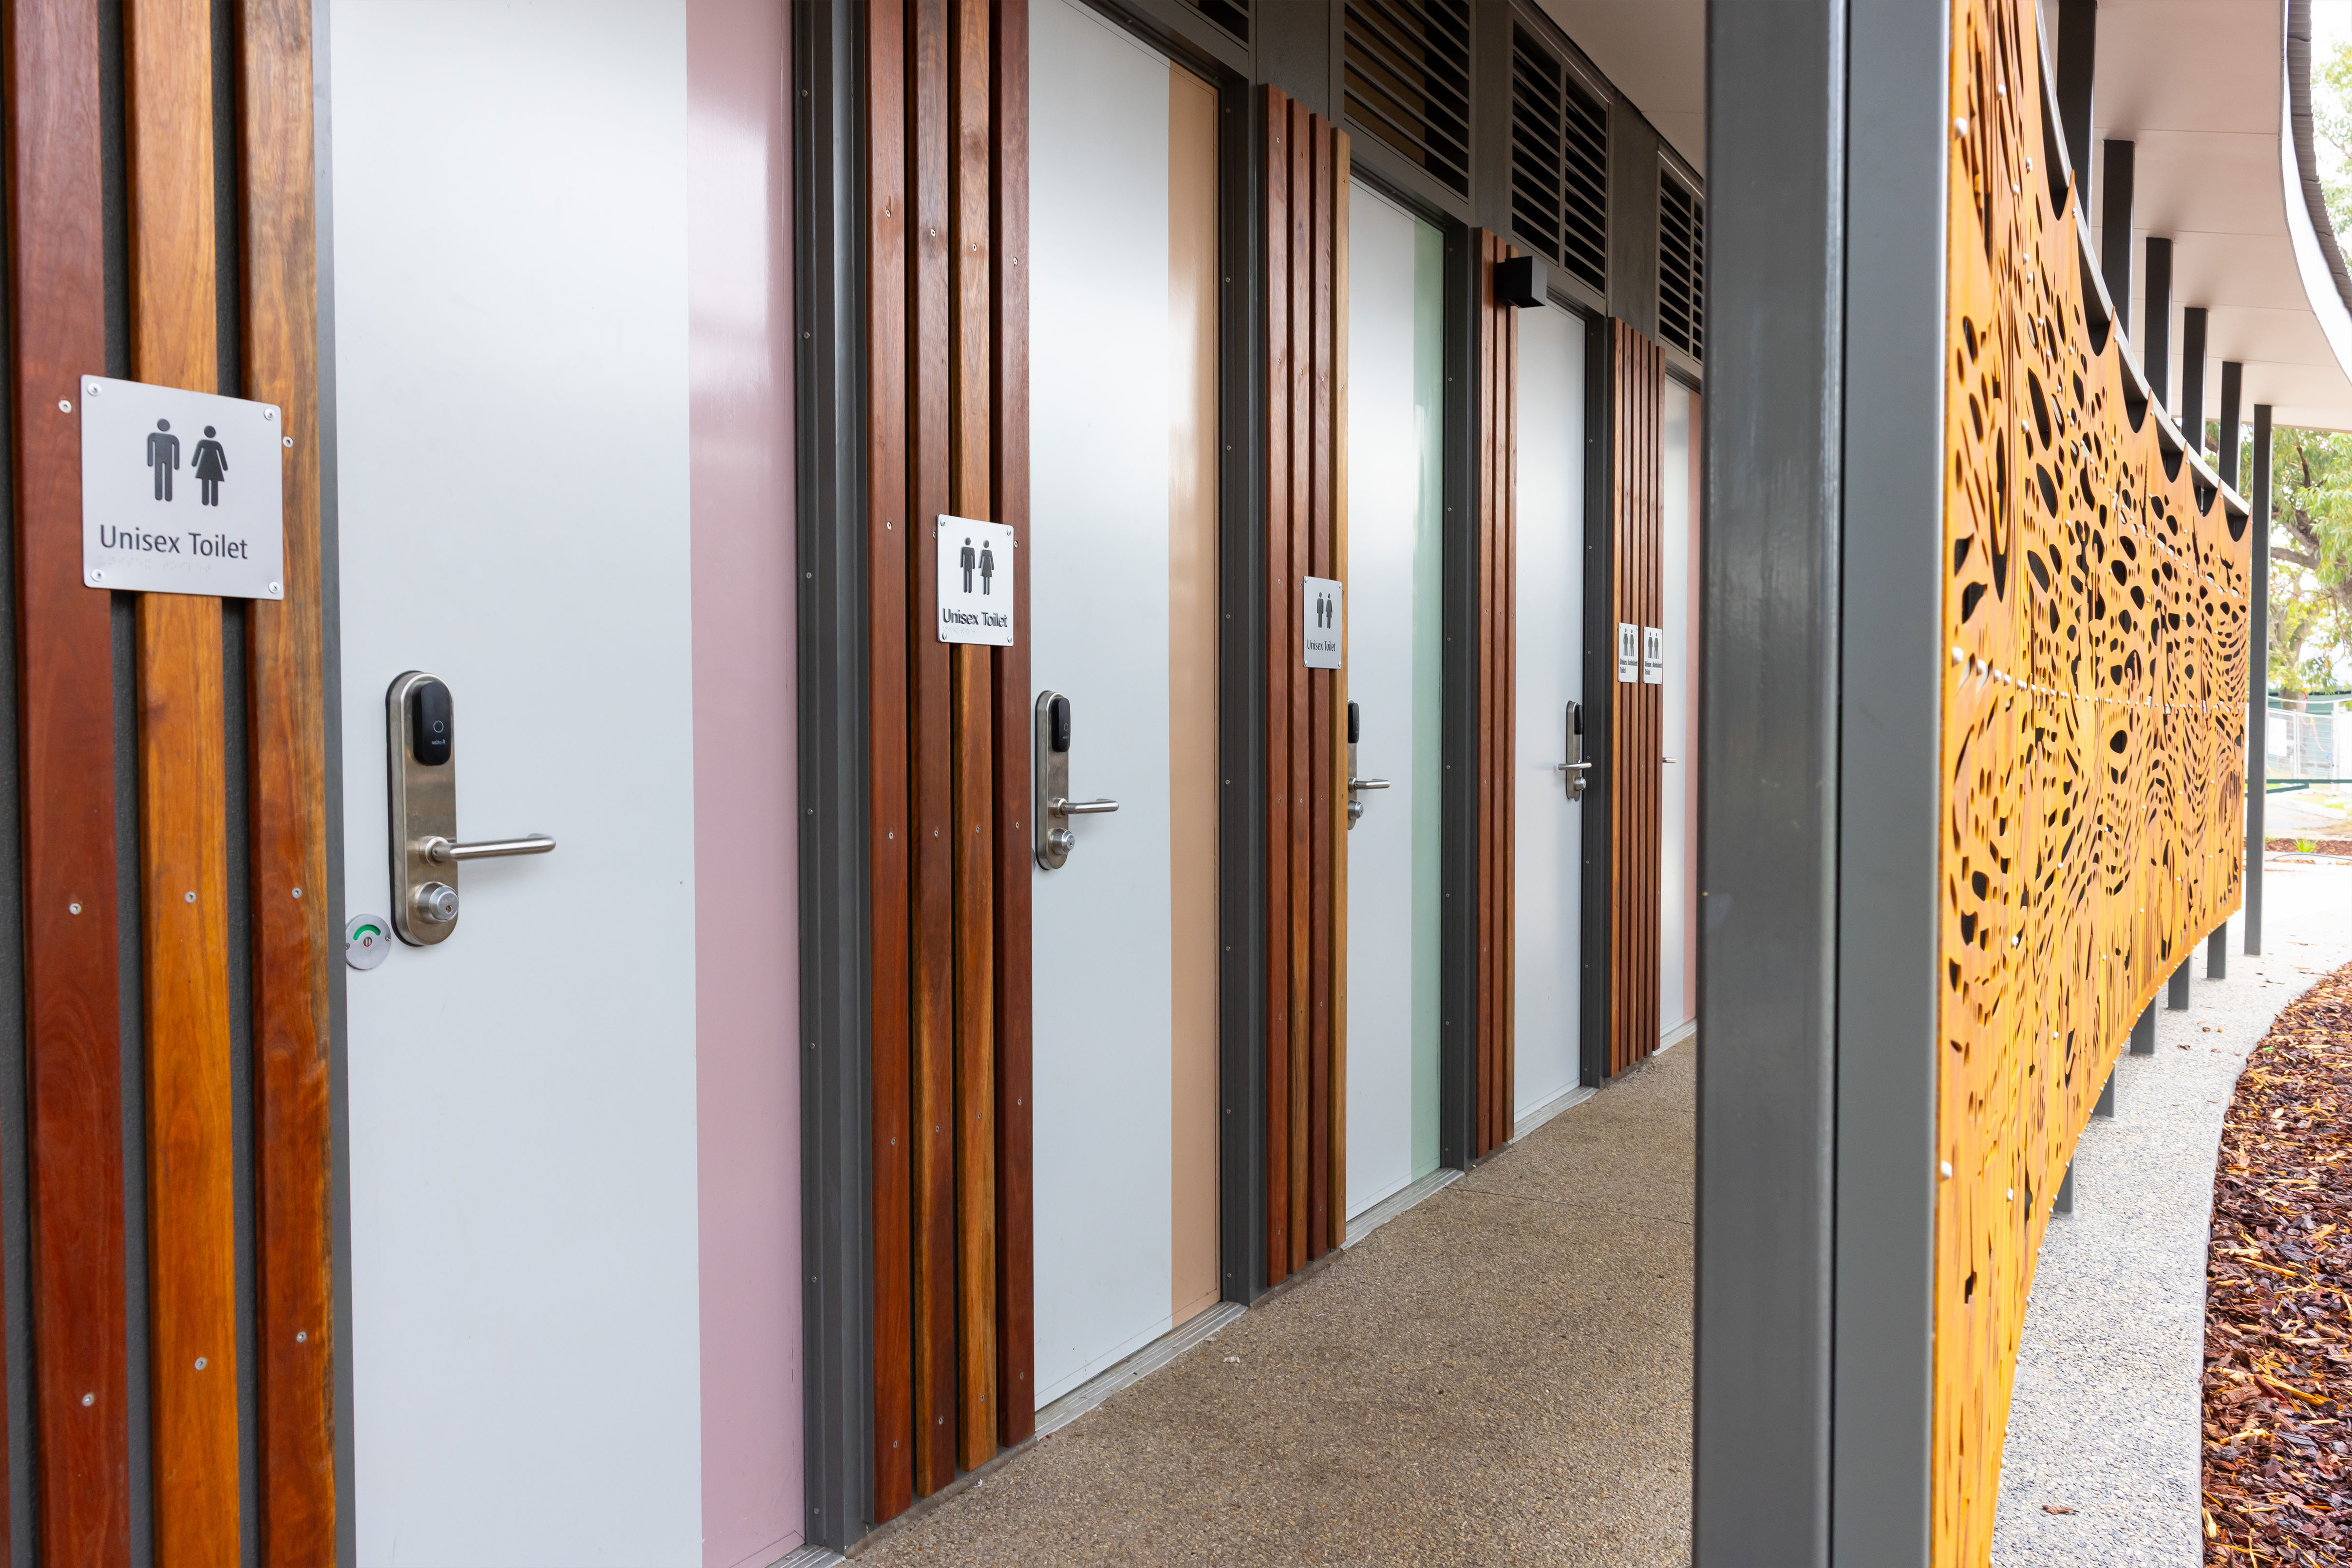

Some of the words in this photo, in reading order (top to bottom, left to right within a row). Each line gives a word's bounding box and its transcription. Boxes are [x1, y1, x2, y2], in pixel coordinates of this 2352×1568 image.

[100, 524, 180, 554] Unisex
[188, 532, 248, 560] Toilet
[942, 608, 978, 625] Unisex
[981, 611, 1008, 627] Toilet
[1307, 639, 1323, 651] Unisex
[1324, 640, 1336, 652] Toilet
